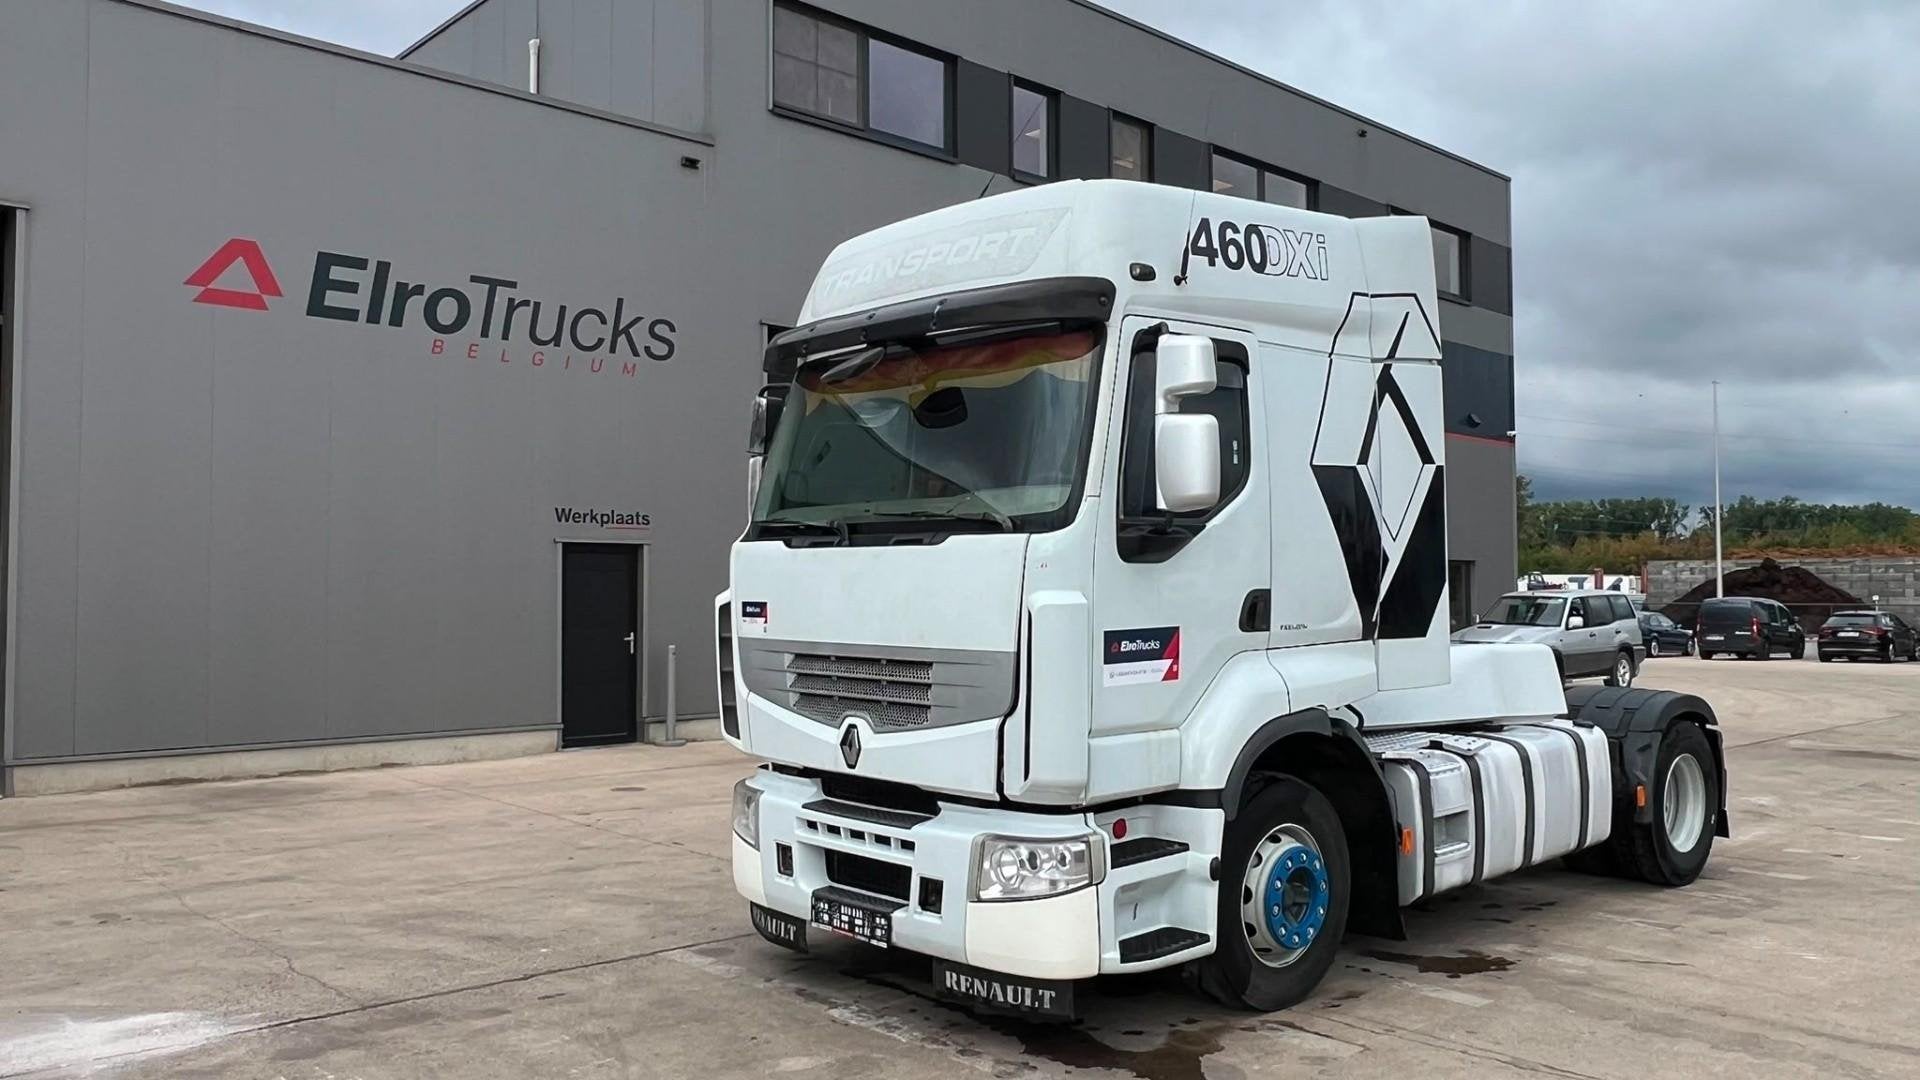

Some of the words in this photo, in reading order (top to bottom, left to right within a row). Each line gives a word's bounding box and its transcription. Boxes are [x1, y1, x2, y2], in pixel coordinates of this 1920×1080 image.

[823, 227, 1038, 296] TRANSPORT
[306, 250, 677, 362] ElroTrucks
[431, 338, 638, 378] BELGIUM
[554, 507, 651, 527] Werkplaats
[1120, 639, 1160, 652] ElroTrucks
[945, 970, 1056, 1009] RENAULT
